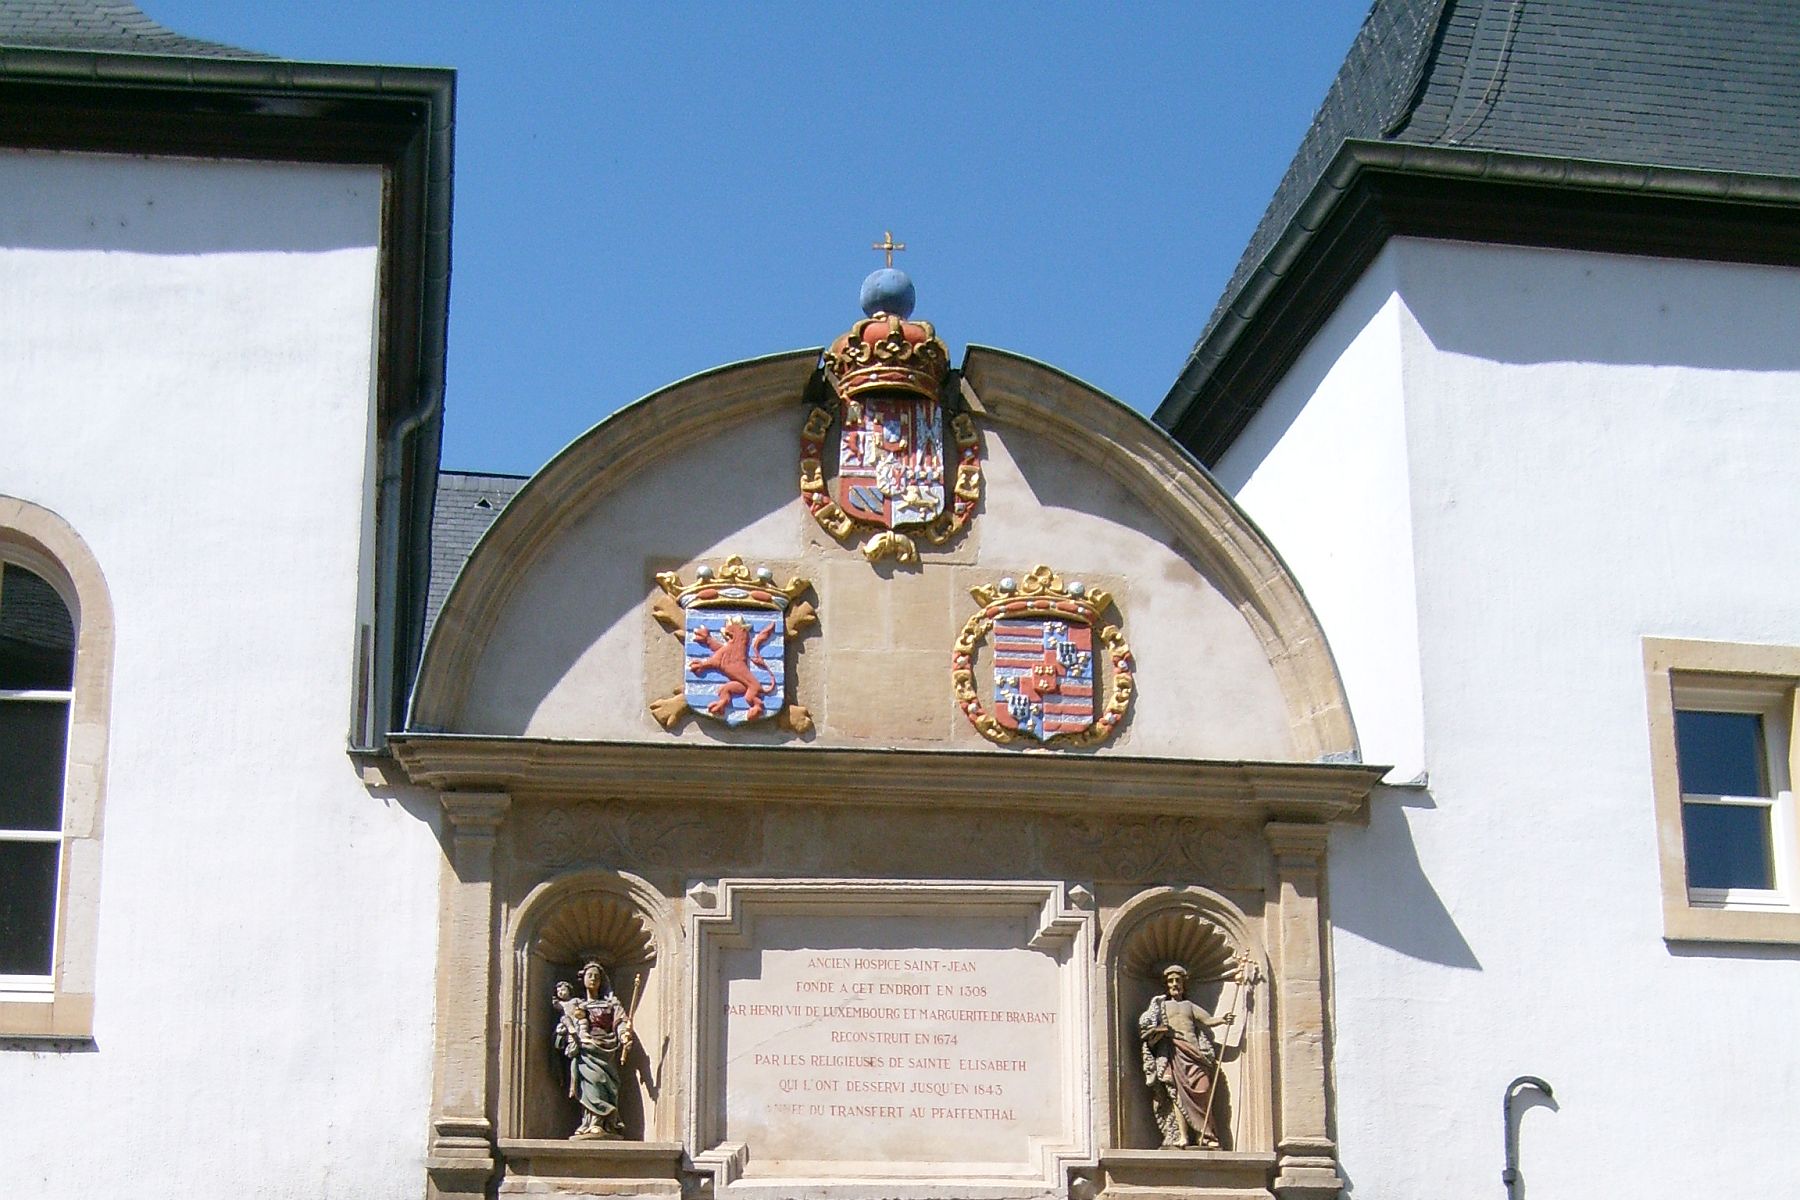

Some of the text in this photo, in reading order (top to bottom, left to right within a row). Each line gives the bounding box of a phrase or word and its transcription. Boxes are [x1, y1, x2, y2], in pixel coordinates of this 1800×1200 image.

[808, 958, 976, 972] ANCIEN HOSPICE SAINT-JEAN
[840, 983, 848, 994] A
[852, 983, 874, 994] CET
[879, 984, 931, 996] ENDROIT
[937, 985, 953, 996] EN
[960, 986, 987, 998] 1308
[724, 1004, 1057, 1024] PAR HENRI VII DE LUXEMBOURG ET MARGUERITE DE BRABANT
[832, 1031, 958, 1046] RECONSTRUIT EN 1674
[755, 1054, 1027, 1072] PAR LES RELIGIEUSES DE SAINTE ELISABETH
[778, 1079, 798, 1092] QUI
[846, 1081, 905, 1093] DESSERVI
[974, 1084, 1003, 1096] 1843
[810, 1104, 825, 1116] DU
[829, 1105, 904, 1118] TRANSFERT
[910, 1107, 925, 1118] AU
[932, 1107, 1017, 1120] PFAFFENTHAL
